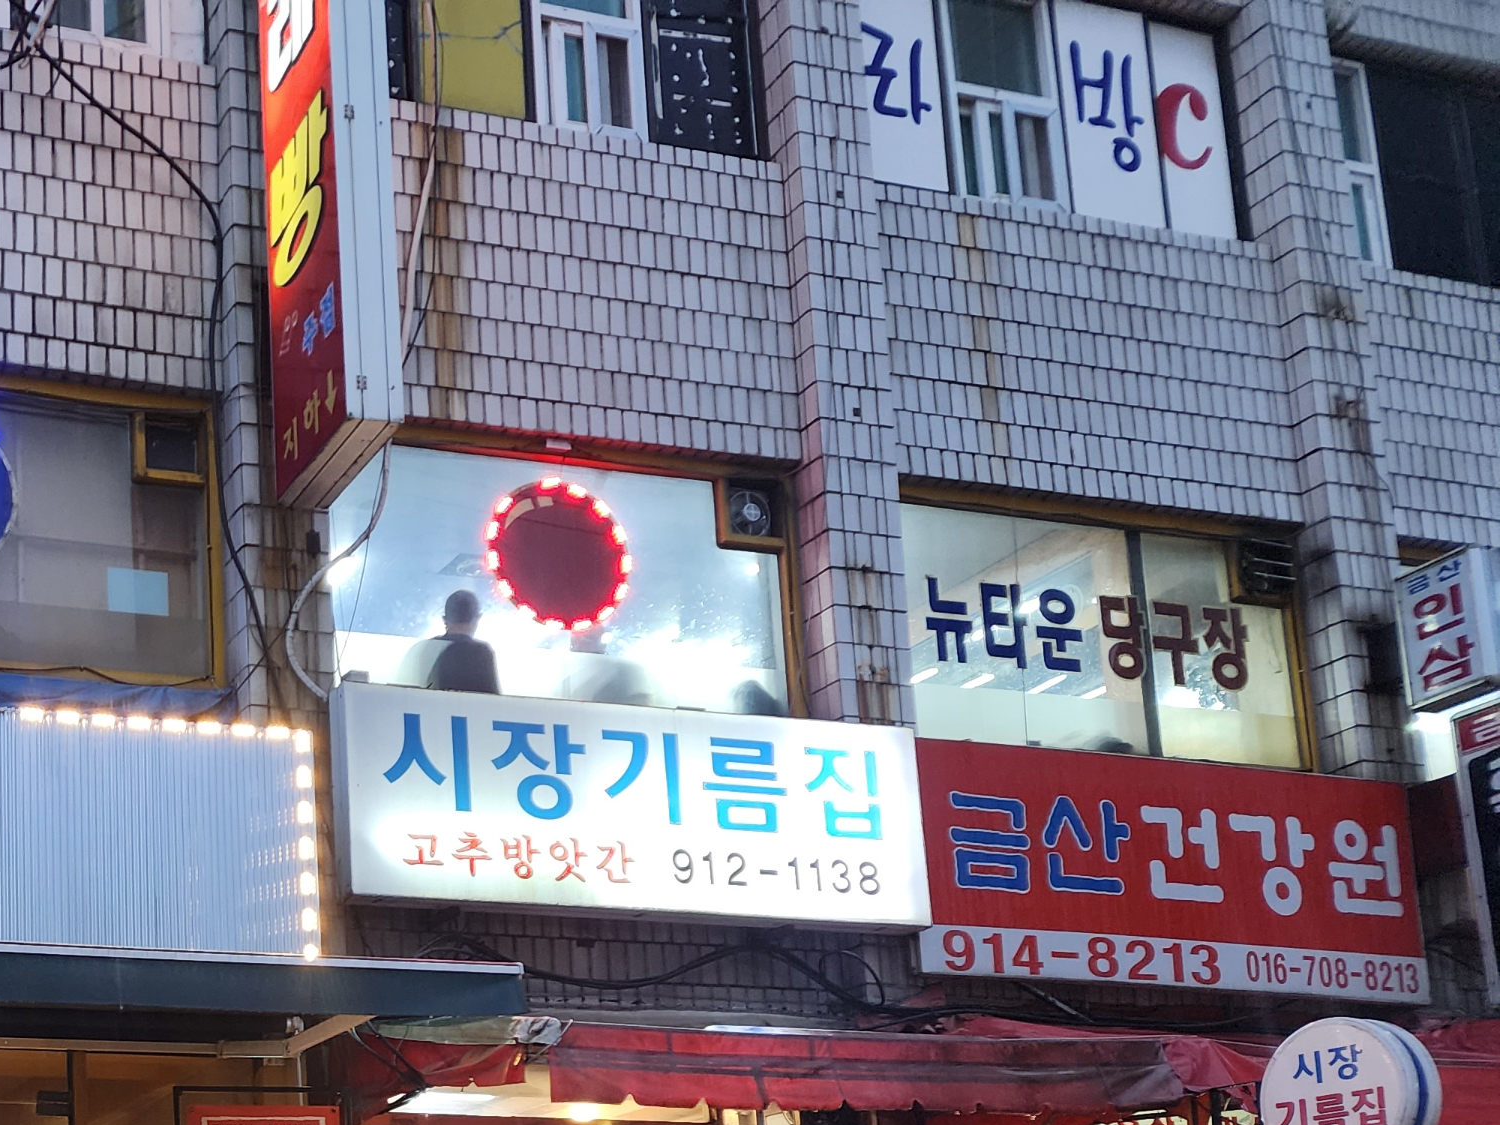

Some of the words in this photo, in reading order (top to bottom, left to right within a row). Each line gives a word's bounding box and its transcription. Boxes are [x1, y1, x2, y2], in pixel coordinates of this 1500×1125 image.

[283, 388, 321, 460] 지하
[1407, 559, 1463, 595] 금산
[925, 575, 1083, 672] 뉴타운
[1099, 595, 1249, 691] 당구장
[1413, 583, 1475, 692] 인삼
[384, 713, 884, 840] 시장기름집
[403, 832, 635, 884] 고추방앗간
[672, 849, 881, 895] 912-1138
[950, 790, 1404, 917] 금산건강원
[943, 930, 1221, 985] 914-8213
[1246, 950, 1419, 994] 016-708-8213
[1293, 1044, 1363, 1084] 시장
